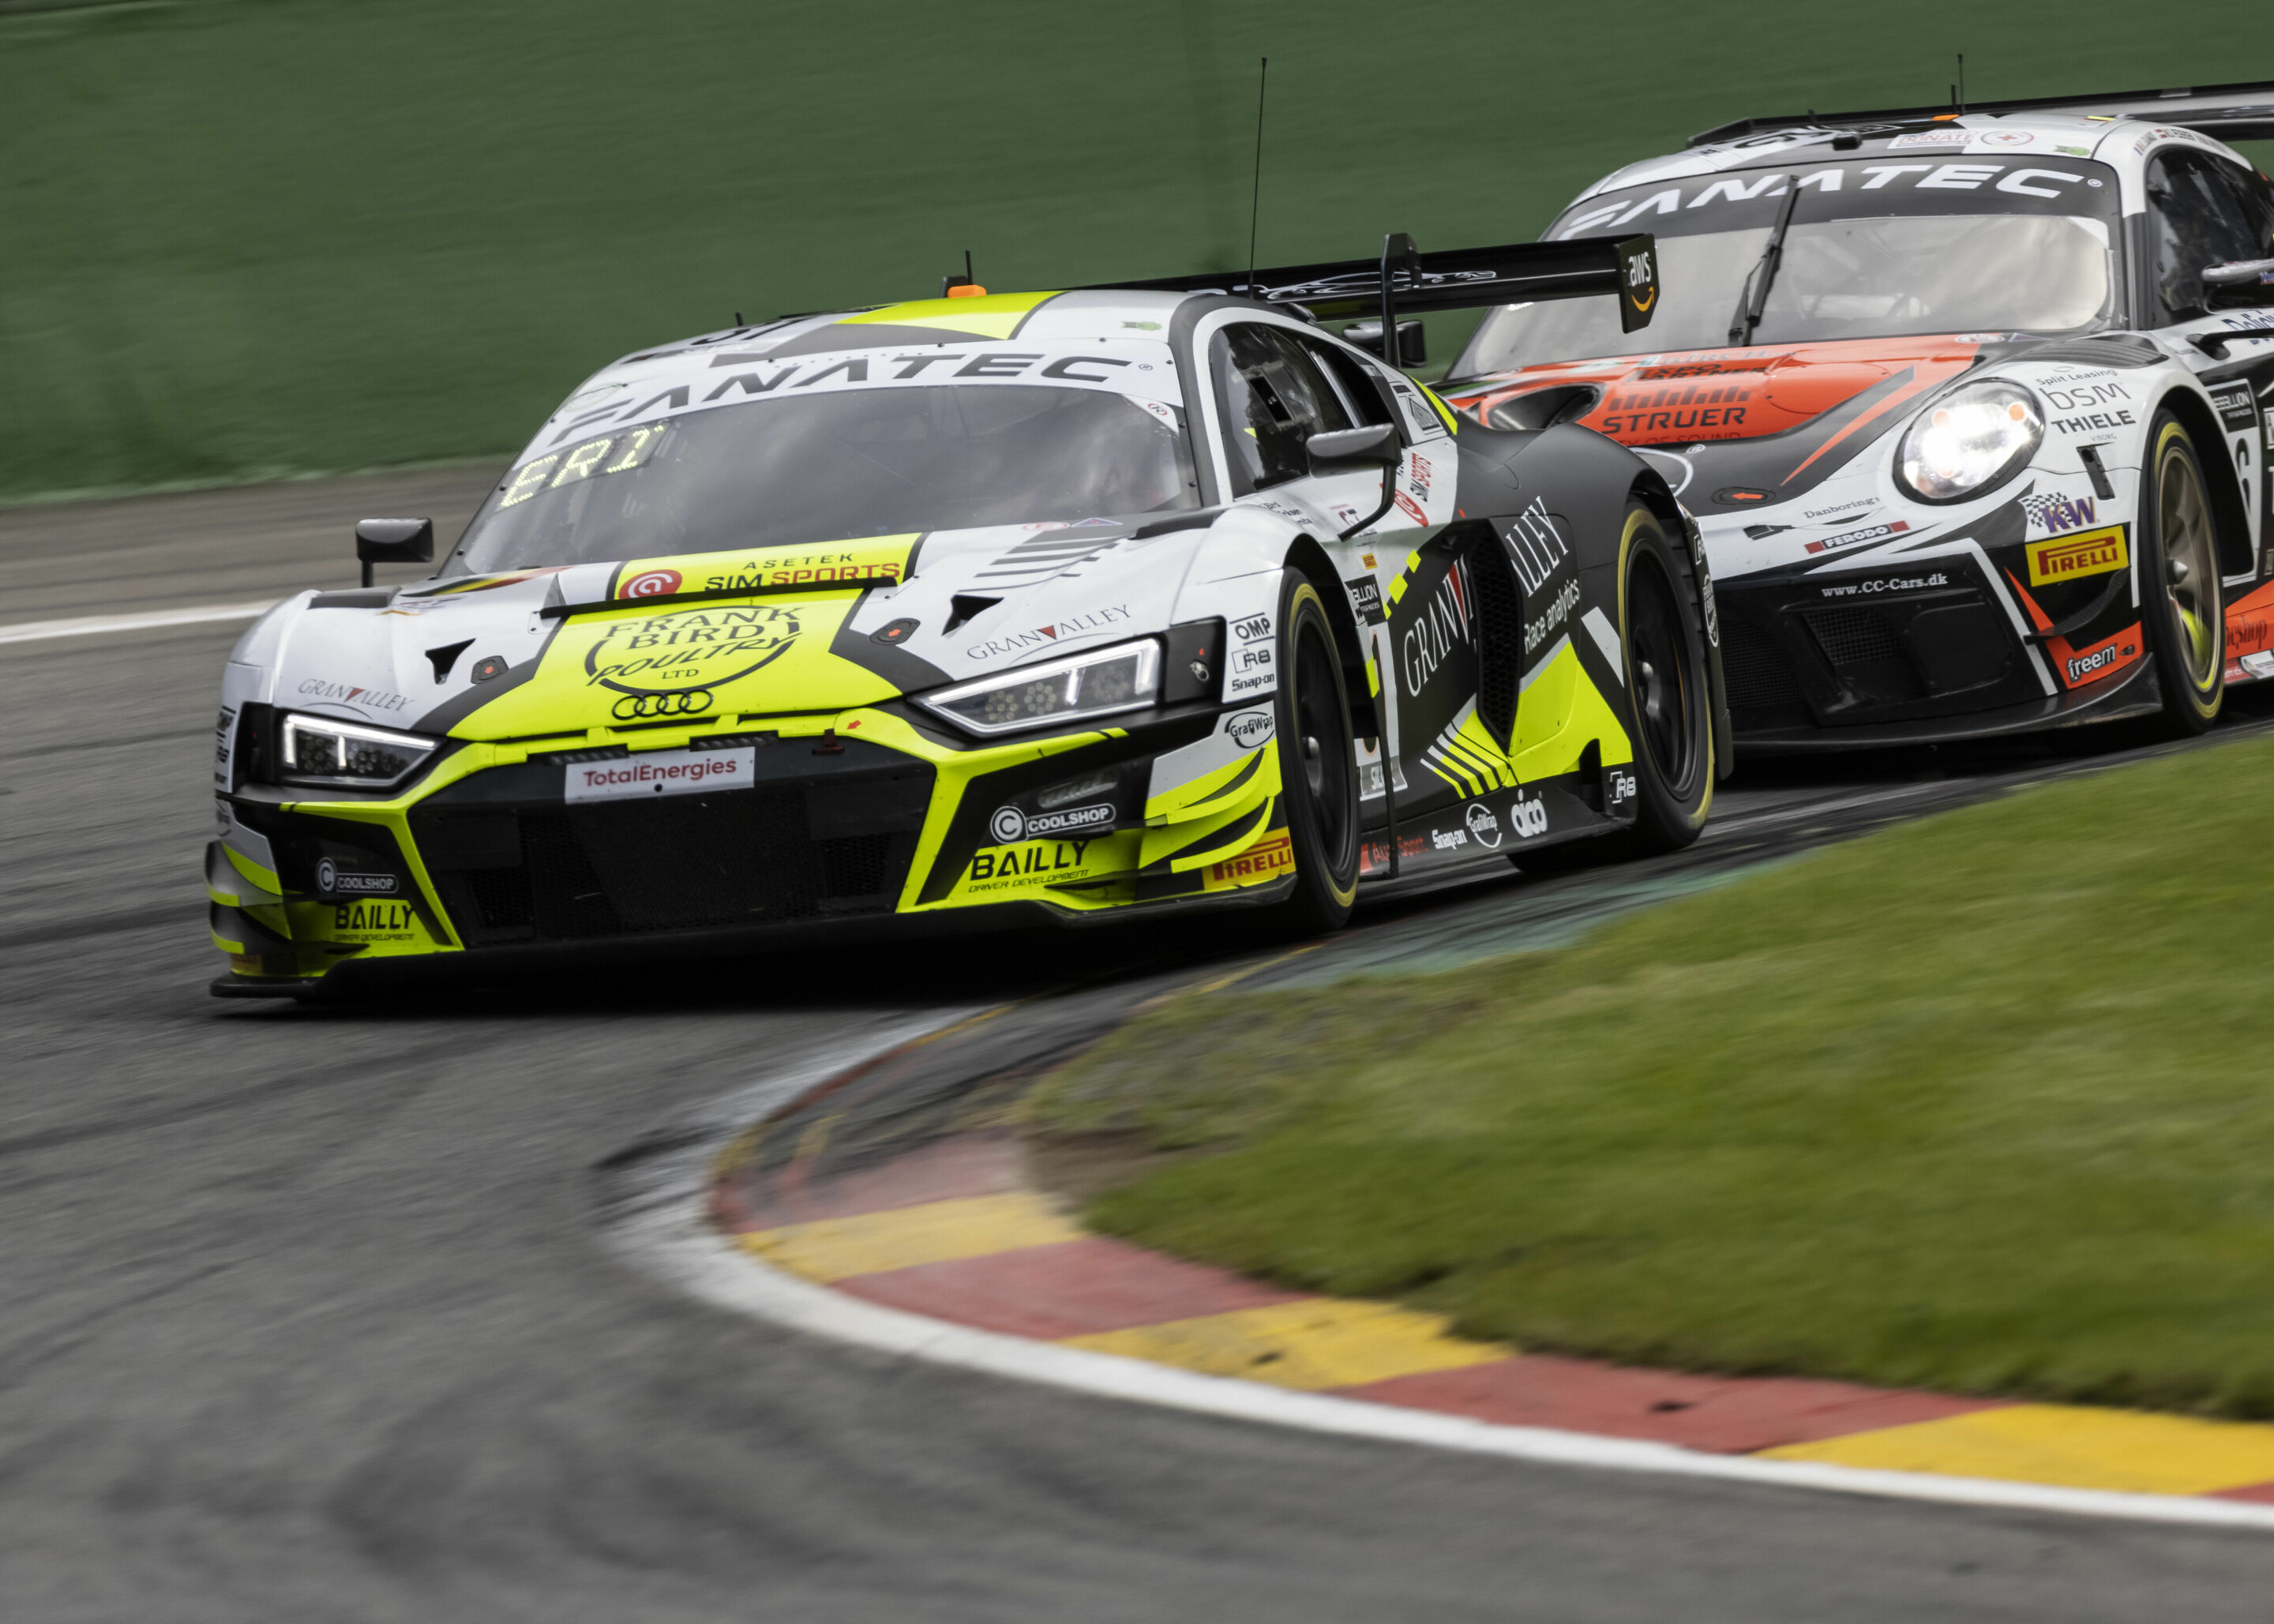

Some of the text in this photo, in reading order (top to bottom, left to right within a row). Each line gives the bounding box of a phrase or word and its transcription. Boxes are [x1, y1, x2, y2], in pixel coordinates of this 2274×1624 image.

[1559, 164, 2084, 241] FANATEC
[1629, 252, 1652, 287] aws
[2036, 369, 2118, 386] Split Leasing
[548, 353, 1132, 447] FANATEC
[1600, 407, 1747, 434] STRUER
[2051, 410, 2137, 434] THIELE
[2041, 496, 2096, 534] KW
[1823, 526, 1889, 548] FERODO
[743, 553, 854, 570] ASETEK
[2037, 535, 2118, 576] PIRELLI
[704, 562, 901, 592] SIM SPORTS
[1822, 573, 1949, 598] www.CC-Cars.dk
[606, 606, 805, 638] FRANK
[1234, 617, 1270, 640] OMP
[1524, 578, 1580, 654] Race analytics
[626, 624, 765, 651] BIRD
[587, 632, 802, 687] POULTRY
[1243, 650, 1271, 668] R8
[662, 668, 700, 680] LTD
[1232, 673, 1275, 692] Snap-on
[583, 757, 737, 787] TotalEnergies
[1615, 776, 1637, 798] R8
[1027, 807, 1109, 833] COOLSHOP
[970, 840, 1090, 881] BAILLY
[1212, 836, 1293, 882] PIRELLI
[336, 876, 395, 890] COOLSHOP
[968, 869, 1090, 894] DRIVER DEVELOPMENT
[335, 904, 413, 930] BAILLY
